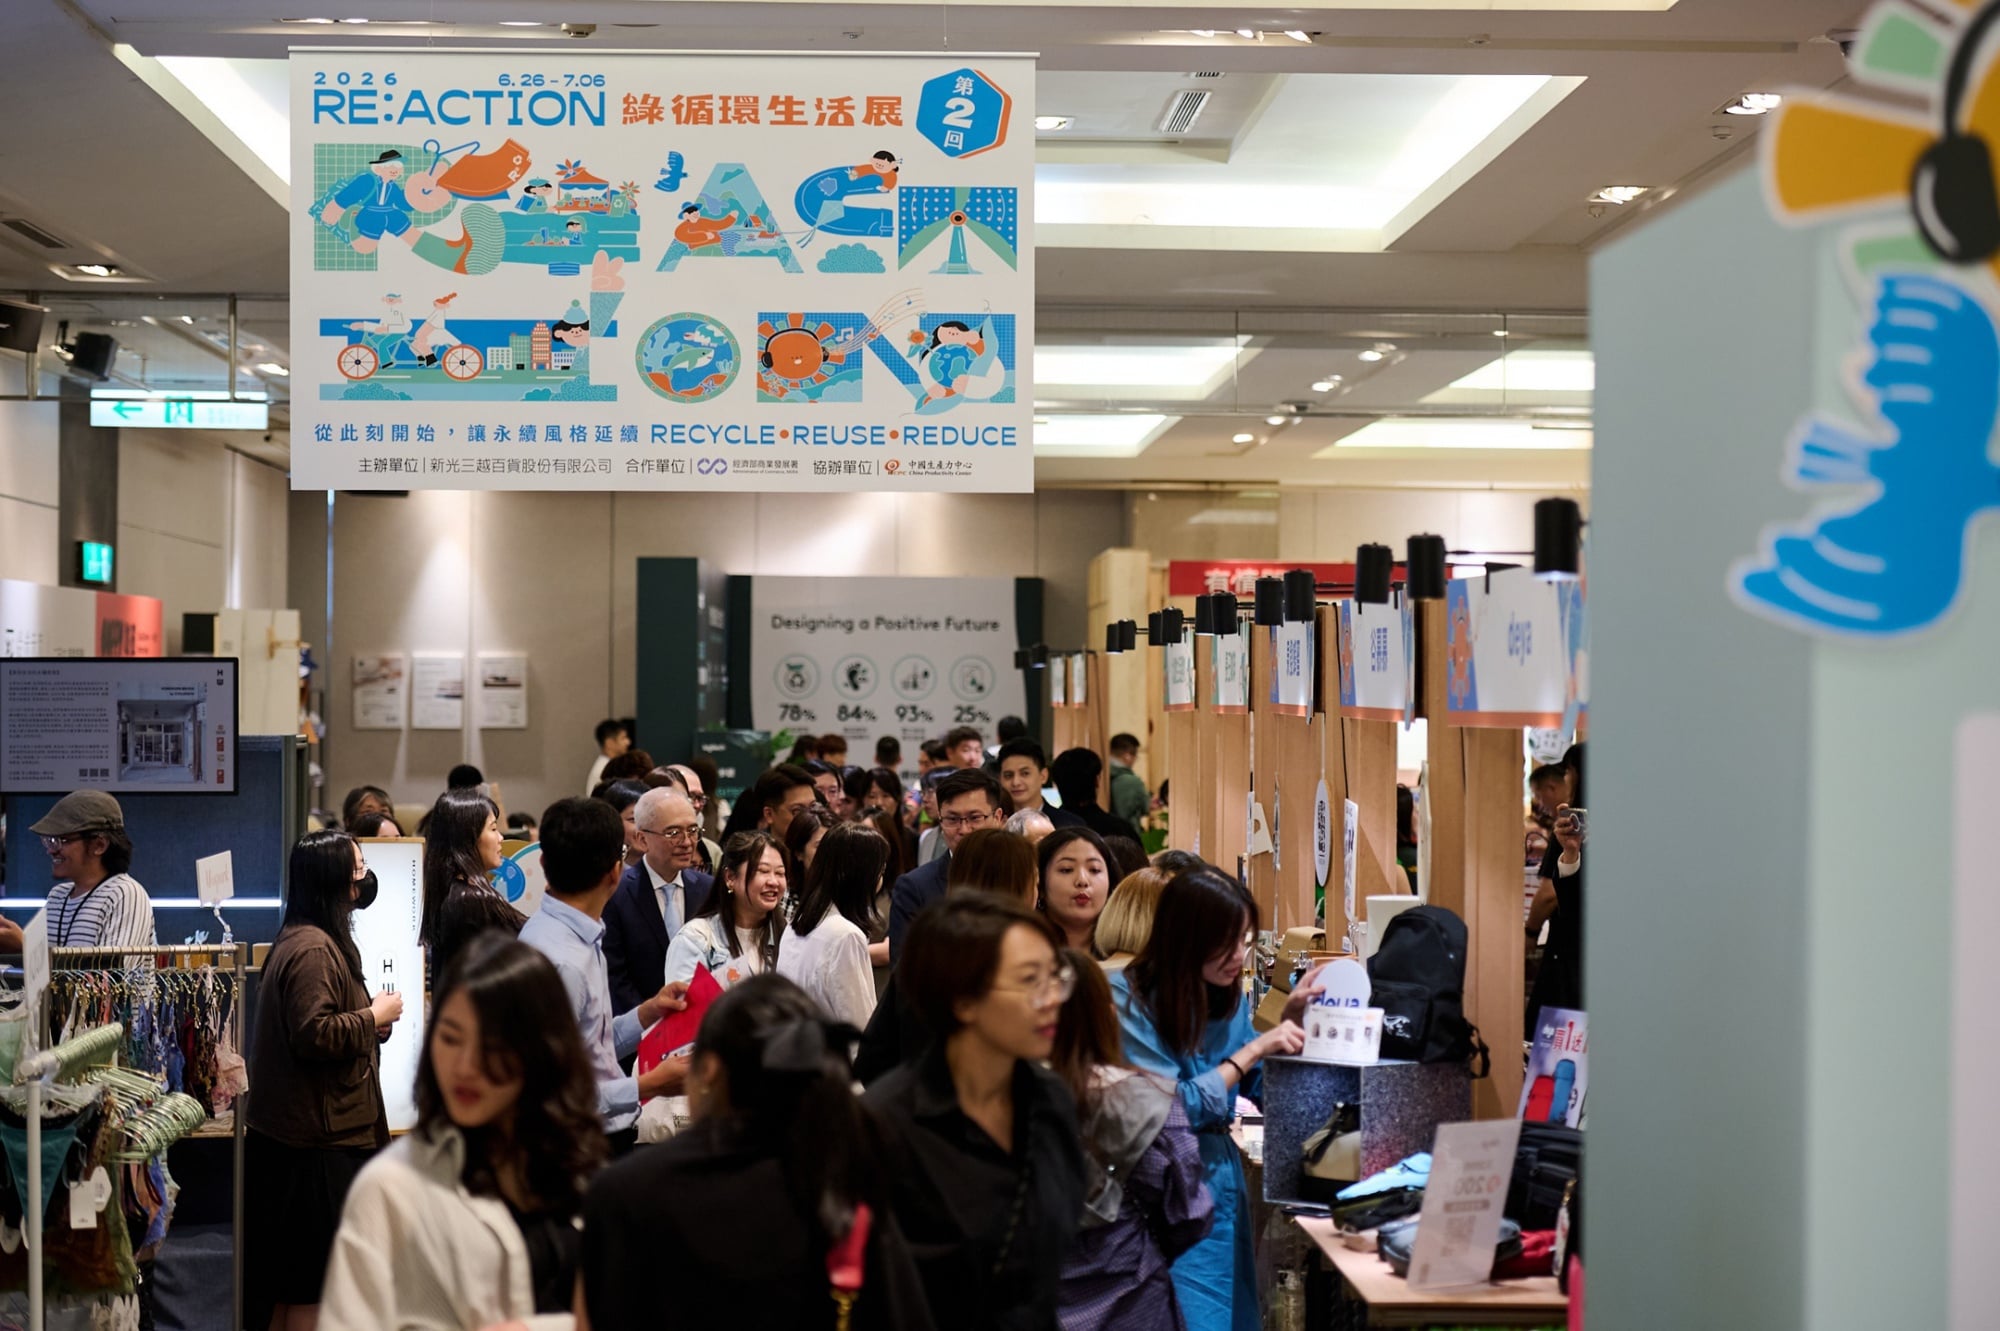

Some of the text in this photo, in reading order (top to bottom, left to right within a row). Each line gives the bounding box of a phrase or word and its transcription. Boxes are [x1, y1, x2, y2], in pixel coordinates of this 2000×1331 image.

[314, 72, 397, 85] 2026
[313, 89, 606, 127] RE:ACTION
[622, 93, 904, 127] 綠循環生活展
[314, 423, 1017, 447] 從此刻開始，讓永續風格延續 RECYCLE REUSE REDUCE
[358, 457, 419, 474] 主辦單位
[430, 457, 612, 475] 新光三越百貨股份有限公司
[625, 458, 686, 475] 合作單位
[813, 460, 873, 476] 協辦單位
[908, 460, 973, 469] 中國生產力中心
[770, 614, 1000, 634] Designing a Positive Future
[779, 704, 817, 722] 78%
[836, 704, 878, 723] 84%
[895, 704, 933, 723] 93%
[954, 705, 992, 723] 25%
